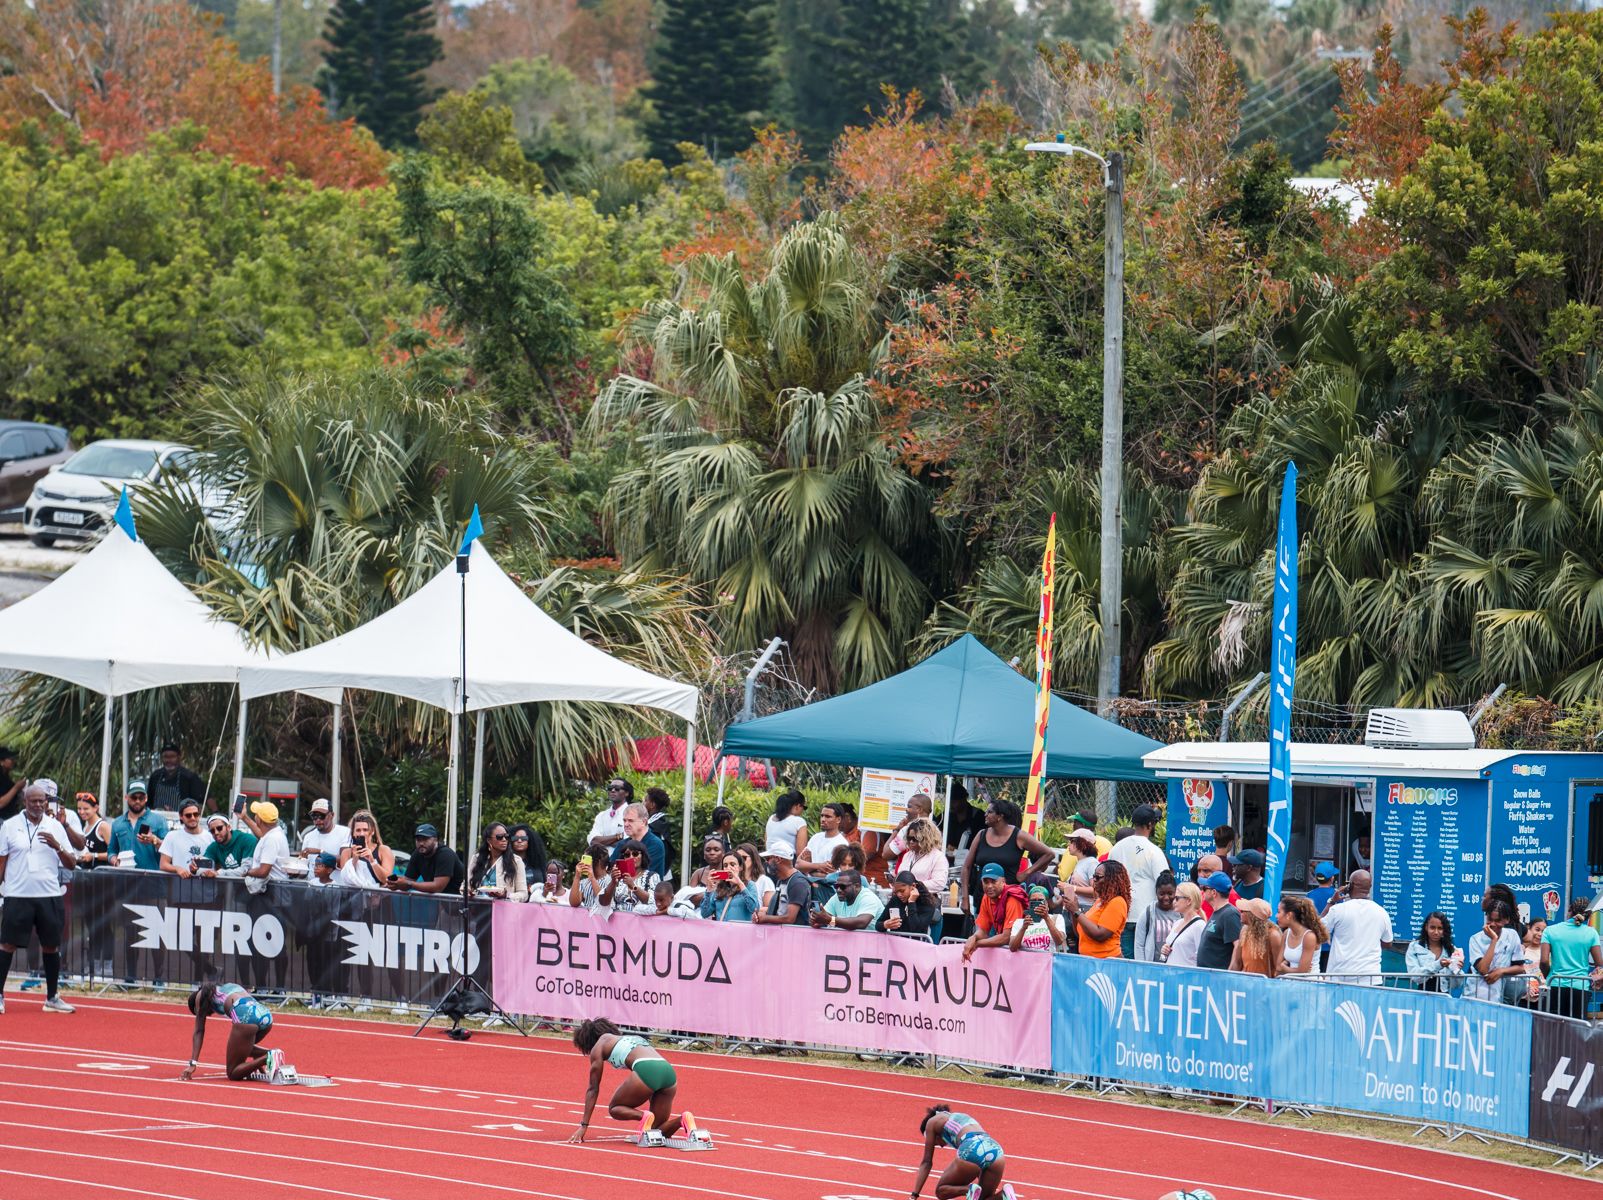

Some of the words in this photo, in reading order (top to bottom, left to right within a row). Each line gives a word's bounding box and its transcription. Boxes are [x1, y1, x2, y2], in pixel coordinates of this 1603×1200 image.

[1388, 781, 1458, 806] Flavors
[1514, 788, 1528, 798] Snow
[1528, 788, 1541, 798] Balls
[1504, 800, 1521, 811] Regular
[1522, 800, 1525, 808] &
[1526, 800, 1540, 810] Sugar
[1540, 800, 1551, 808] Free
[1508, 811, 1525, 823] Fluffy
[1526, 811, 1545, 821] Shakes
[1182, 826, 1197, 836] Snow
[1198, 827, 1212, 836] Balls
[1519, 825, 1535, 834] Water
[1172, 838, 1191, 848] Regular
[1197, 839, 1212, 849] Sugar
[1512, 836, 1528, 847] Fluffy
[1529, 836, 1539, 847] Dog
[1177, 849, 1195, 860] Fluffy
[1462, 853, 1474, 862] MED
[1475, 852, 1483, 862] $6
[1504, 861, 1550, 876] 535-0053
[1462, 873, 1473, 882] LRG
[1474, 873, 1483, 883] $7
[1463, 894, 1470, 903] XL
[1471, 894, 1479, 904] $9
[122, 904, 284, 958] NITRO
[330, 920, 480, 975] NITRO
[1023, 935, 1050, 948] THING
[536, 928, 732, 984] BERMUDA
[536, 975, 673, 1006] GoToBermuda.com
[824, 954, 1012, 1013] BERMUDA
[1116, 976, 1248, 1046] ATHENE
[824, 1003, 966, 1034] GoToBermuda.com
[1366, 1006, 1497, 1077] ATHENE
[1116, 1042, 1162, 1070] Driven
[1166, 1052, 1180, 1073] to
[1185, 1050, 1205, 1076] do
[1365, 1072, 1414, 1102] Driven
[1421, 1083, 1437, 1104] to
[1443, 1082, 1460, 1108] do
